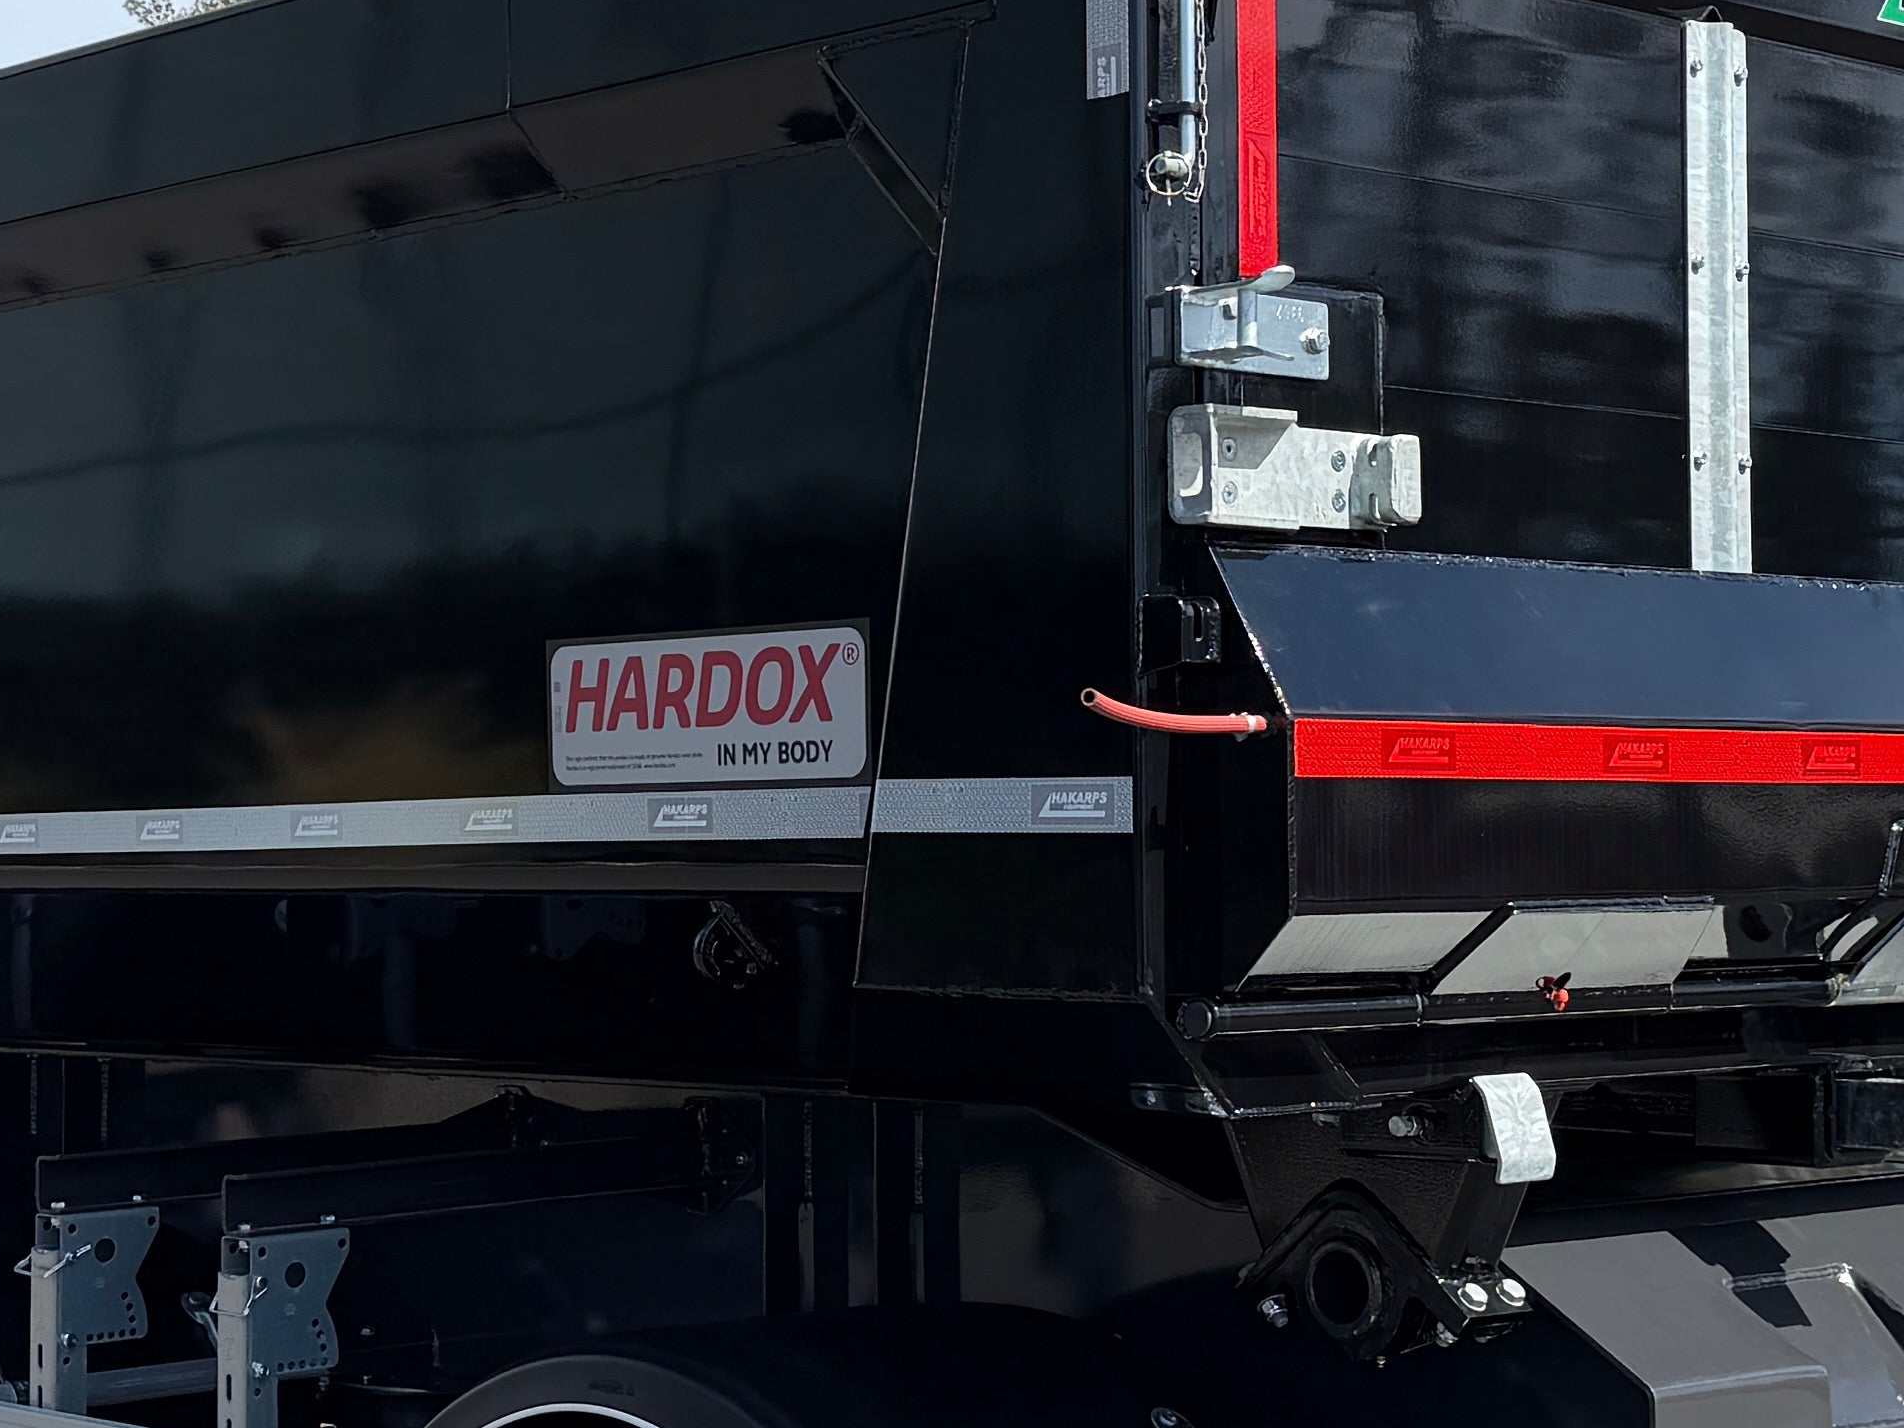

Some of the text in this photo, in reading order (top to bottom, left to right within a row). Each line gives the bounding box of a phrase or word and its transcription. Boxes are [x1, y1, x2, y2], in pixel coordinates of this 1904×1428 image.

[565, 642, 841, 733] HARDOX
[717, 742, 736, 766] IN
[743, 740, 772, 765] MY
[778, 738, 834, 763] BODY
[1051, 791, 1108, 804] HAKARPS
